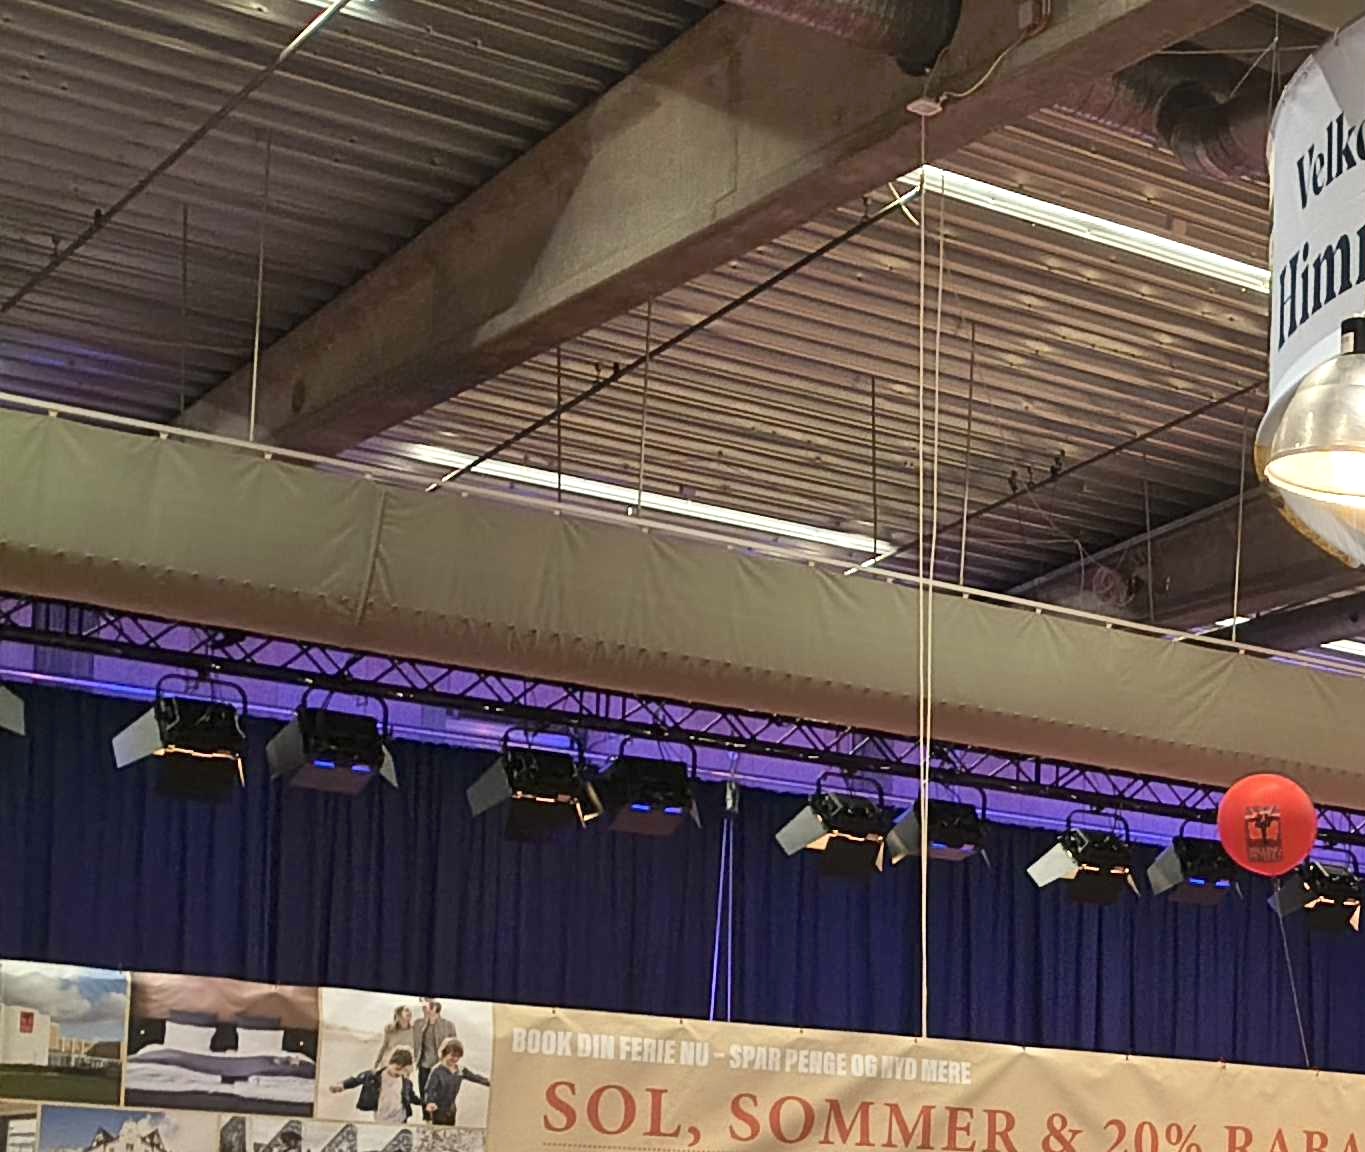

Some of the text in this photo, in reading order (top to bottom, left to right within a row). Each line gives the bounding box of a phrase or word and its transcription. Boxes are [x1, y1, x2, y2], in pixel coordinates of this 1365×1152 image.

[512, 1028, 572, 1057] BOOK
[576, 1033, 614, 1060] DIN
[619, 1036, 675, 1065] FERIE
[680, 1039, 710, 1067] NU
[728, 1043, 781, 1071] SPAR
[785, 1048, 847, 1077] PENGE
[851, 1054, 878, 1078] OG
[881, 1056, 917, 1082] NYD
[921, 1059, 972, 1085] MERE
[543, 1080, 702, 1147] SOL,
